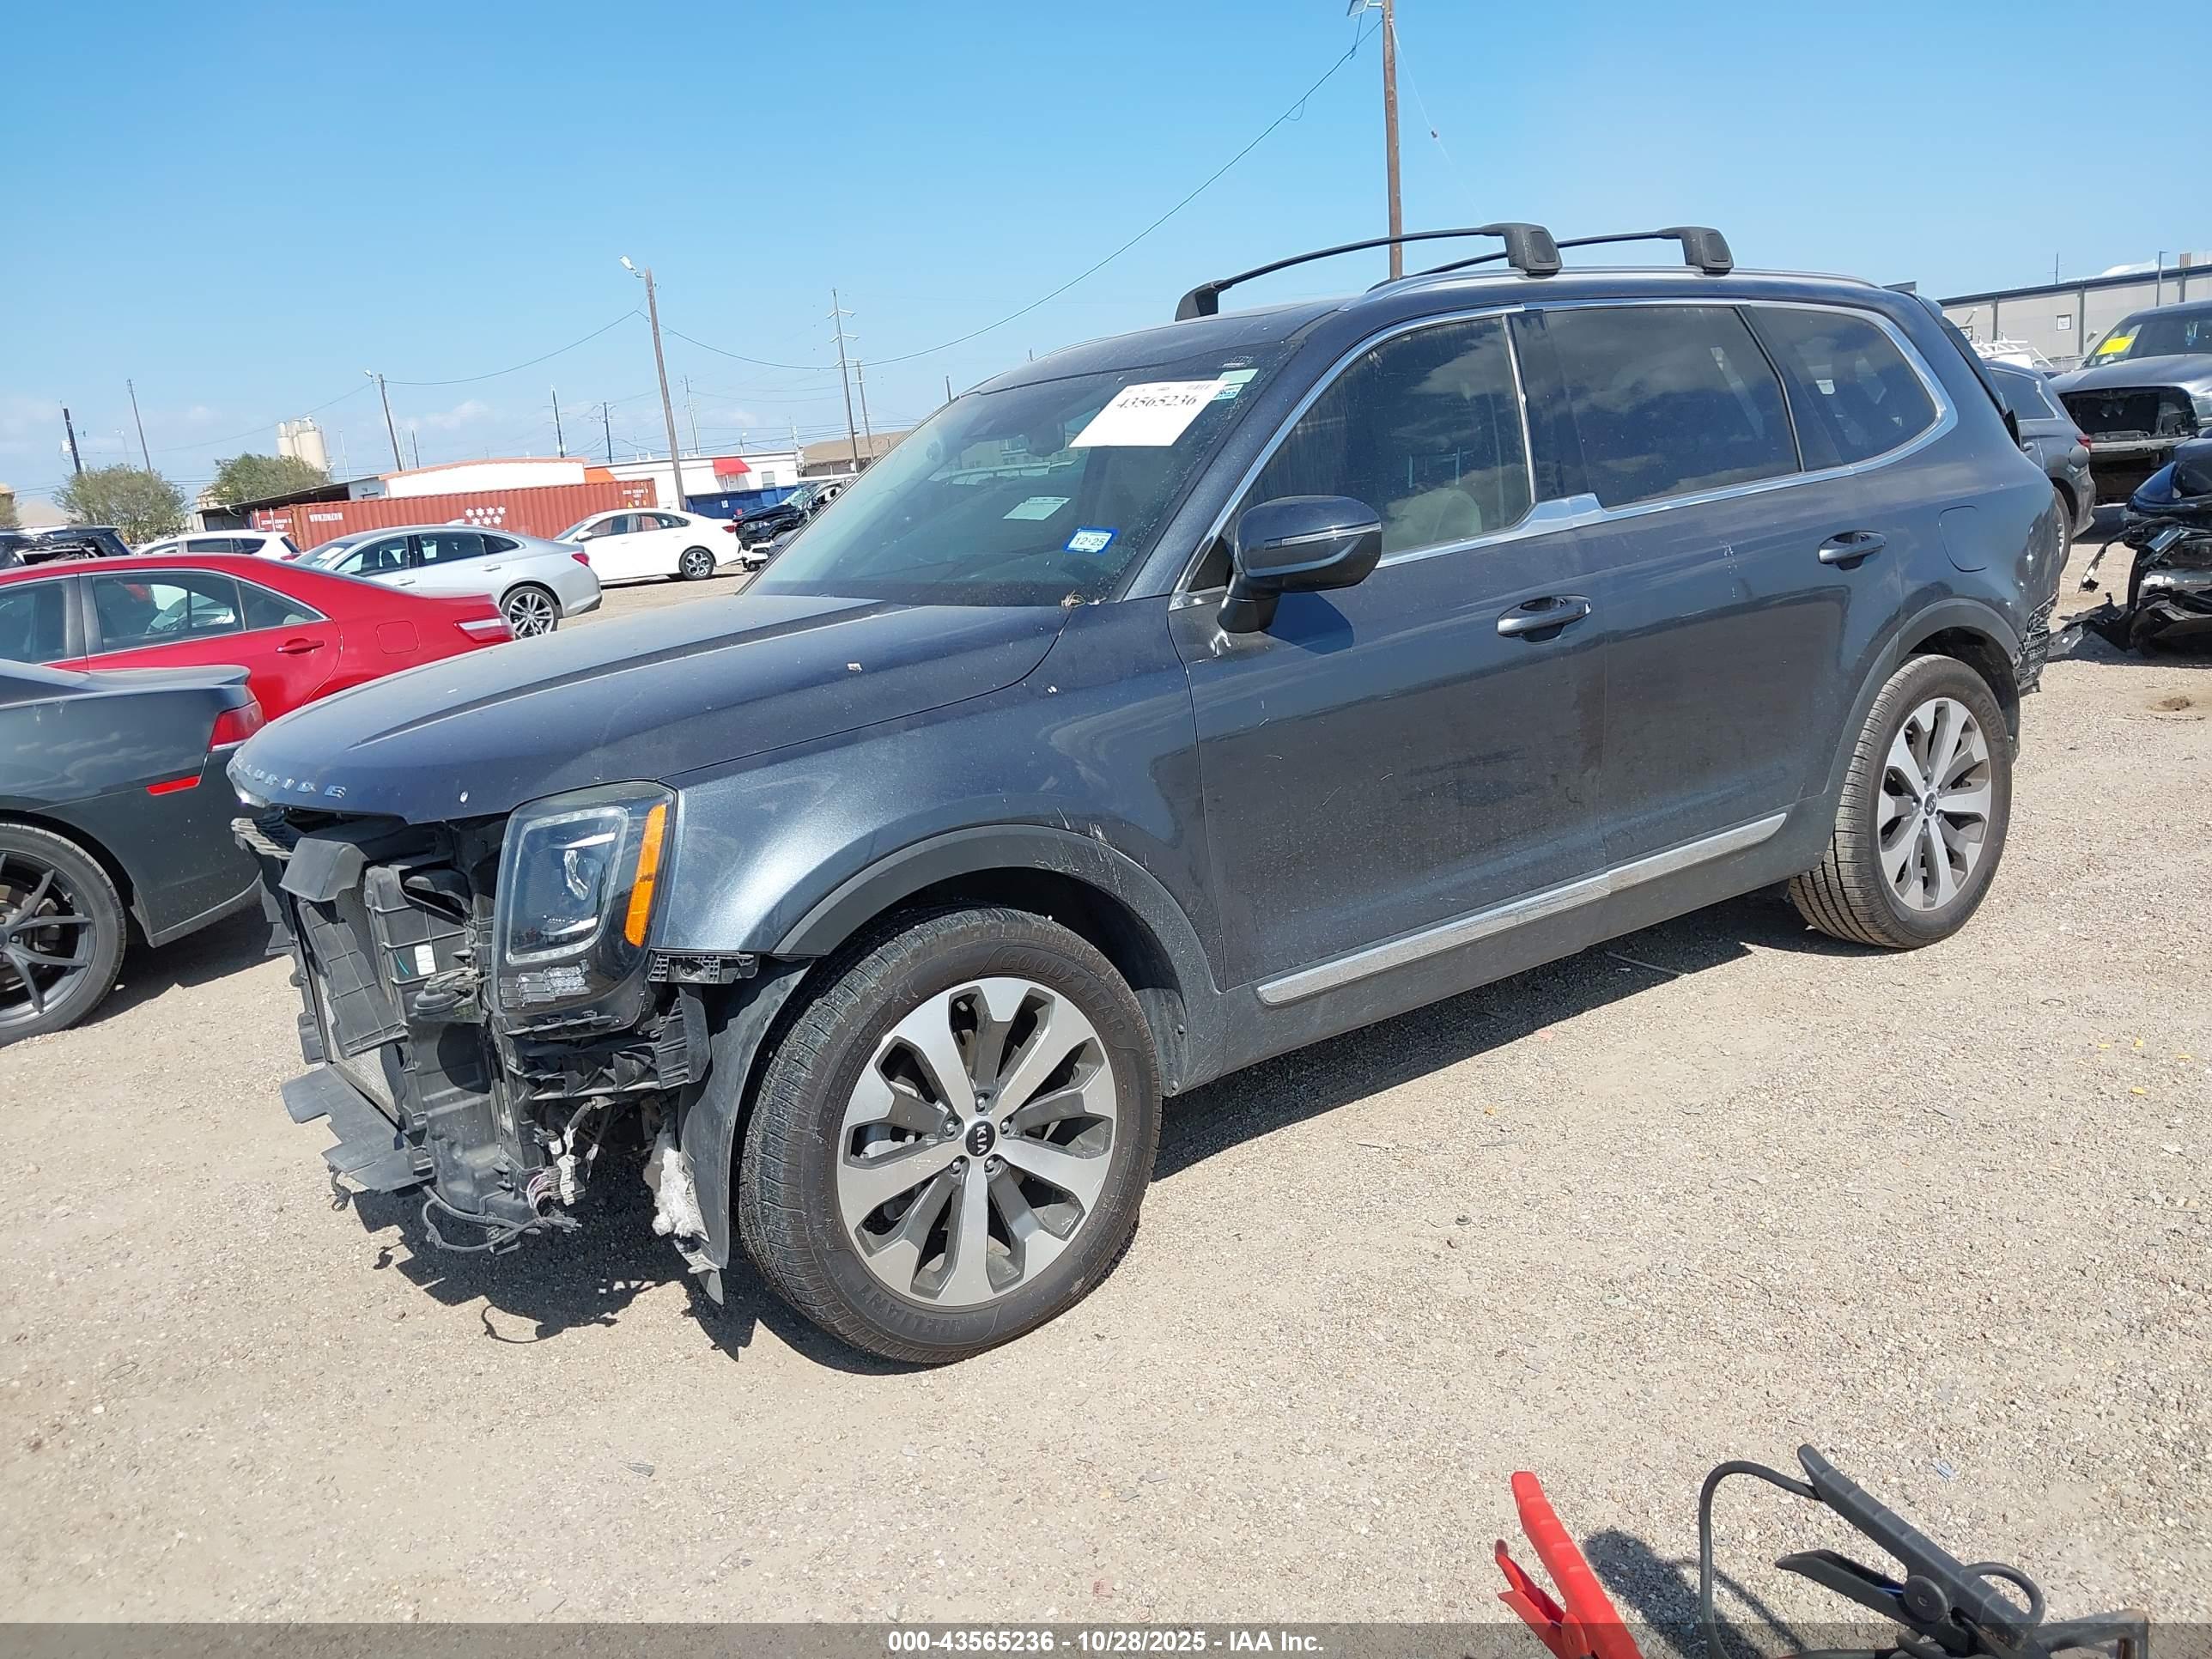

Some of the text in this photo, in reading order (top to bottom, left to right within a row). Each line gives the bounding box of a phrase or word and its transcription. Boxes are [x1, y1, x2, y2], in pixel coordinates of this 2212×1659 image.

[1116, 394, 1200, 408] 43565236
[1001, 951, 1127, 1034] GOODYEAR
[976, 1125, 988, 1155] KIA
